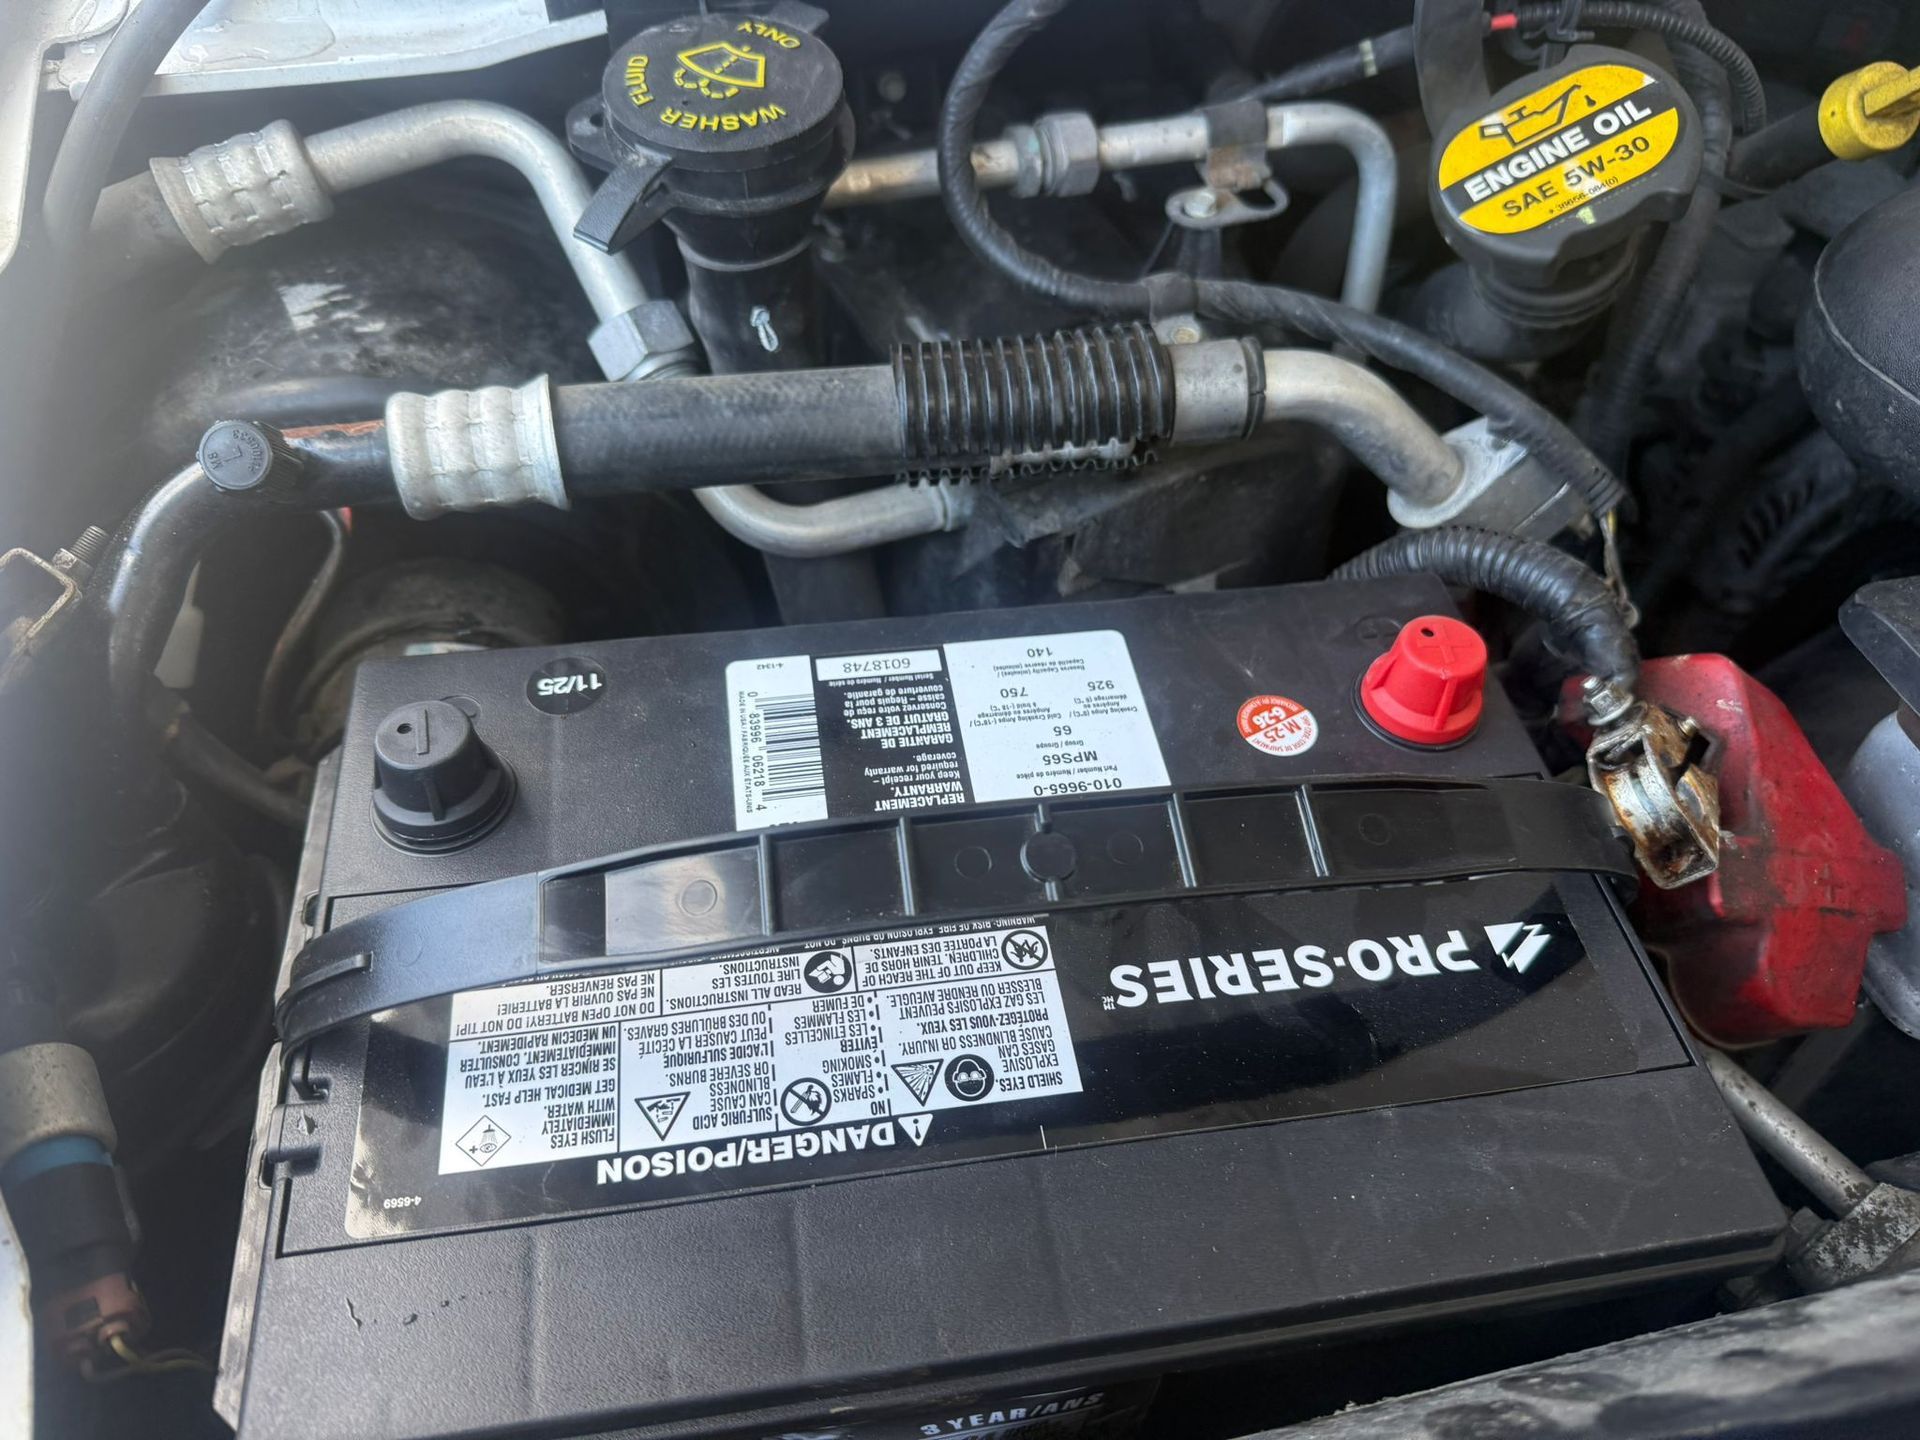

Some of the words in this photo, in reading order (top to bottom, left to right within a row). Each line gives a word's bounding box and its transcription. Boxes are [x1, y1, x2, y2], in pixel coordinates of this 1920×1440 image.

[737, 21, 801, 50] ONLY
[624, 54, 654, 108] FLUID
[660, 103, 787, 132] WASHER
[1463, 125, 1591, 203] ENGINE
[1592, 99, 1653, 137] OIL
[1502, 180, 1560, 218] SAE
[1562, 135, 1650, 188] 5W-30
[1026, 646, 1053, 658] 140
[842, 657, 911, 673] 6018748
[536, 673, 603, 696] 11/25
[999, 686, 1028, 698] 750
[1086, 679, 1115, 692] 925
[746, 690, 759, 698] 0
[846, 716, 873, 729] ANS.
[874, 716, 884, 727] 3
[884, 714, 901, 726] DE
[902, 710, 949, 725] GRATUIT
[748, 712, 762, 743] 83996
[860, 721, 952, 739] REMPLACEMENT
[1052, 724, 1072, 737] 65
[1263, 717, 1302, 743] M-25
[879, 737, 896, 749] DE
[897, 732, 954, 748] GARANTIE
[912, 751, 957, 762] coverage.
[1041, 749, 1098, 766] MPS65
[751, 754, 766, 787] 06218
[863, 765, 904, 777] warranty
[905, 764, 919, 773] for
[920, 759, 959, 772] required
[935, 769, 961, 779] Keep
[880, 774, 913, 786] receipt
[914, 770, 936, 781] your
[890, 780, 963, 797] WARRANTY.
[1033, 777, 1122, 798] 010-9665-0
[755, 803, 767, 811] 4
[874, 792, 965, 811] REPLACEMENT
[920, 941, 942, 955] DES
[942, 936, 983, 953] PORTÉE
[982, 935, 997, 948] LA
[869, 943, 919, 960] ENFANTS.
[944, 947, 1000, 964] CHILDREN.
[719, 955, 800, 975] INSTRUCTIONS.
[864, 961, 879, 974] DE
[880, 957, 911, 972] HORS
[911, 953, 943, 968] TENIR
[975, 960, 1002, 974] KEEP
[776, 967, 801, 982] LIRE
[877, 970, 913, 986] REACH
[914, 967, 936, 981] THE
[937, 965, 951, 979] OF
[953, 963, 974, 977] OUT
[545, 977, 614, 996] RENVERSER.
[616, 974, 638, 989] PAS
[640, 972, 655, 986] NE
[711, 976, 731, 990] LES
[733, 971, 775, 987] TOUTES
[861, 974, 876, 987] OF
[996, 977, 1043, 995] BLESSER
[616, 987, 638, 1002] PAS
[640, 985, 655, 999] NE
[750, 986, 771, 1000] ALL
[773, 982, 802, 997] READ
[936, 984, 979, 1002] RENDRE
[979, 982, 996, 997] OU
[1024, 990, 1046, 1005] LES
[497, 998, 552, 1016] BATTERIE!
[554, 996, 569, 1009] LA
[571, 990, 614, 1007] OUVRIR
[665, 988, 749, 1010] INSTRUCTIONS.
[811, 996, 849, 1013] FUMER
[849, 994, 865, 1009] DE
[885, 989, 935, 1008] AVEUGLE.
[946, 995, 1002, 1015] EXPLOSIFS
[1002, 992, 1024, 1008] GAZ
[580, 1006, 611, 1022] OPEN
[612, 1003, 636, 1018] NOT
[638, 1000, 655, 1015] DO
[846, 1007, 867, 1023] LES
[898, 1001, 945, 1020] PEUVENT
[479, 1019, 503, 1034] NOT
[506, 1016, 522, 1031] DO
[525, 1010, 578, 1028] BATTERY!
[670, 1015, 727, 1036] BRÛLURES
[728, 1012, 749, 1028] DES
[750, 1010, 766, 1026] OU
[793, 1010, 845, 1030] FLAMMES
[948, 1016, 968, 1032] LES
[968, 1007, 1049, 1030] PROTÉGEZ-VOUS
[455, 1022, 478, 1036] TIP!
[601, 1024, 616, 1040] UN
[623, 1022, 669, 1041] GRAVES.
[739, 1025, 767, 1043] PEUT
[847, 1022, 868, 1038] LES
[916, 1019, 948, 1035] YEUX.
[1017, 1024, 1053, 1042] CAUSE
[477, 1033, 549, 1054] RAPIDEMENT.
[551, 1026, 599, 1047] MÉDECIN
[677, 1035, 692, 1050] LA
[694, 1029, 737, 1048] CAUSER
[839, 1035, 878, 1055] ÉVITER
[940, 1035, 957, 1051] OR
[958, 1028, 1017, 1049] BLINDNESS
[523, 1040, 616, 1065] IMMÉDIATEMENT.
[638, 1037, 676, 1057] CÉCITÉ
[728, 1042, 769, 1060] L'ACIDE
[897, 1037, 939, 1056] INJURY.
[997, 1043, 1020, 1059] CAN
[1020, 1038, 1056, 1056] GASES
[459, 1052, 520, 1073] CONSULTER
[602, 1056, 616, 1072] SE
[663, 1047, 727, 1069] SULFURIQUE
[821, 1053, 872, 1074] SMOKING
[1001, 1052, 1059, 1073] EXPLOSIVE
[507, 1066, 536, 1084] YEUX
[538, 1063, 558, 1080] LES
[560, 1058, 600, 1077] RINCER
[708, 1062, 751, 1082] SEVERE
[753, 1060, 769, 1076] OR
[464, 1071, 495, 1089] L'EAU
[497, 1070, 505, 1088] À
[594, 1077, 615, 1094] GET
[665, 1068, 707, 1087] BURNS.
[708, 1075, 770, 1097] BLINDNESS
[830, 1068, 874, 1088] FLAMES
[994, 1075, 1026, 1092] EYES.
[1026, 1070, 1063, 1089] SHIELD
[513, 1087, 541, 1104] HELP
[543, 1080, 592, 1100] MEDICAL
[748, 1090, 771, 1107] CAN
[832, 1083, 876, 1103] SPARKS
[481, 1090, 511, 1108] FAST.
[586, 1096, 615, 1114] WITH
[709, 1093, 746, 1113] CAUSE
[869, 1099, 886, 1116] NO
[543, 1100, 584, 1119] WATER.
[720, 1105, 773, 1127] SULFURIC
[541, 1111, 615, 1135] IMMEDIATELY
[692, 1113, 718, 1130] ACID
[550, 1131, 578, 1149] EYES
[580, 1126, 615, 1145] FLUSH
[596, 1121, 895, 1185] DANGER/POISON
[383, 1195, 422, 1209] 4-6569
[919, 1423, 941, 1436] 3
[946, 1392, 1105, 1431] YEAR/ANS
